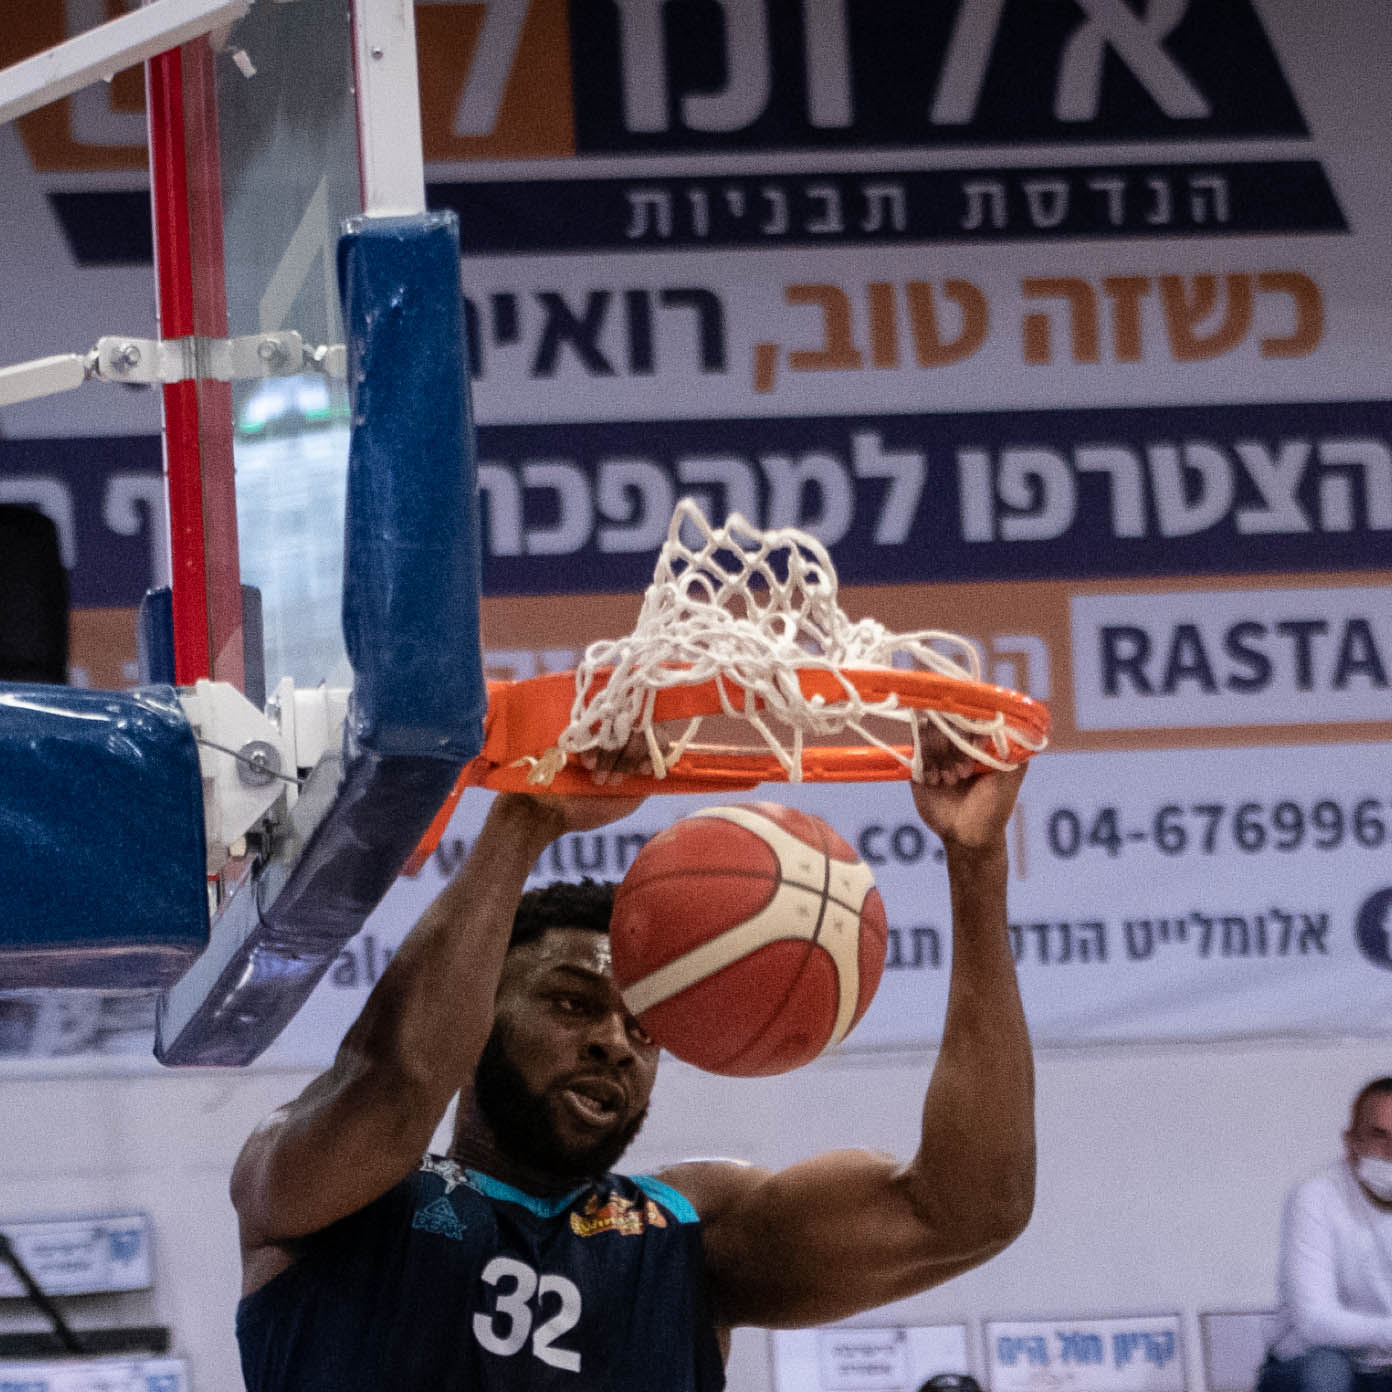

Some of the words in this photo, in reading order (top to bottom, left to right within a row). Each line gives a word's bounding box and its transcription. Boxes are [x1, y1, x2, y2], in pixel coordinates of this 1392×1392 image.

[625, 182, 908, 242] תבניות
[960, 170, 1233, 232] הנדסת
[464, 284, 728, 382] רואי
[750, 278, 991, 394] טוב,
[1016, 270, 1328, 366] כשזה
[1098, 618, 1391, 700] RASTA
[1123, 905, 1330, 963] אלומלייט
[471, 1256, 583, 1374] 32
